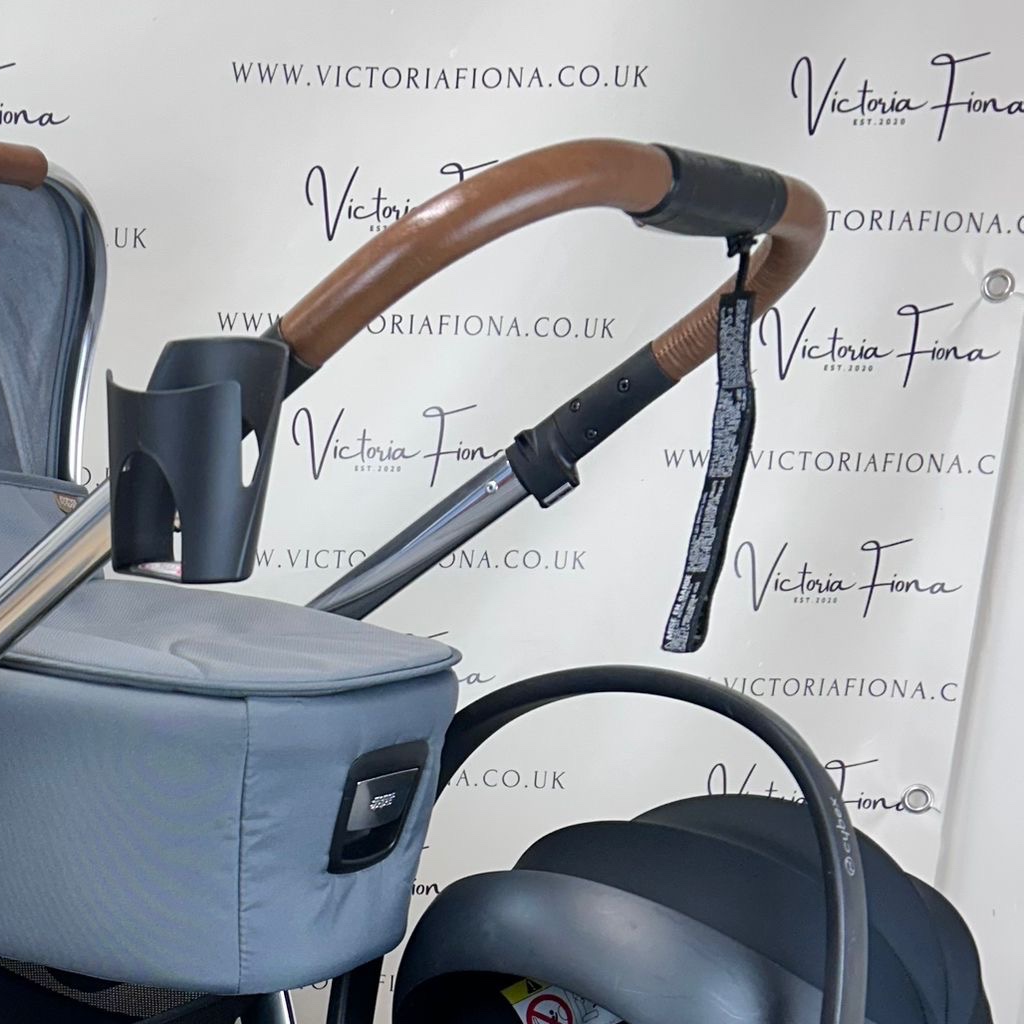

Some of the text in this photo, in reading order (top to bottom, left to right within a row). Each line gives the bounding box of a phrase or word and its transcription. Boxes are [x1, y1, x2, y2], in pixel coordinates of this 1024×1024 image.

[231, 60, 649, 90] WWW.VICTORIAFIONA.CO.UK
[791, 51, 1024, 142] Victoria Fiona
[853, 117, 907, 126] EST.2020
[305, 165, 411, 242] Victori
[759, 306, 896, 382] Victoria
[896, 302, 1002, 388] Fiona
[823, 364, 875, 373] EST.2020
[291, 403, 504, 488] Victoria Fion
[354, 464, 402, 473] EST.2020
[734, 538, 964, 618] Victoria Fiona
